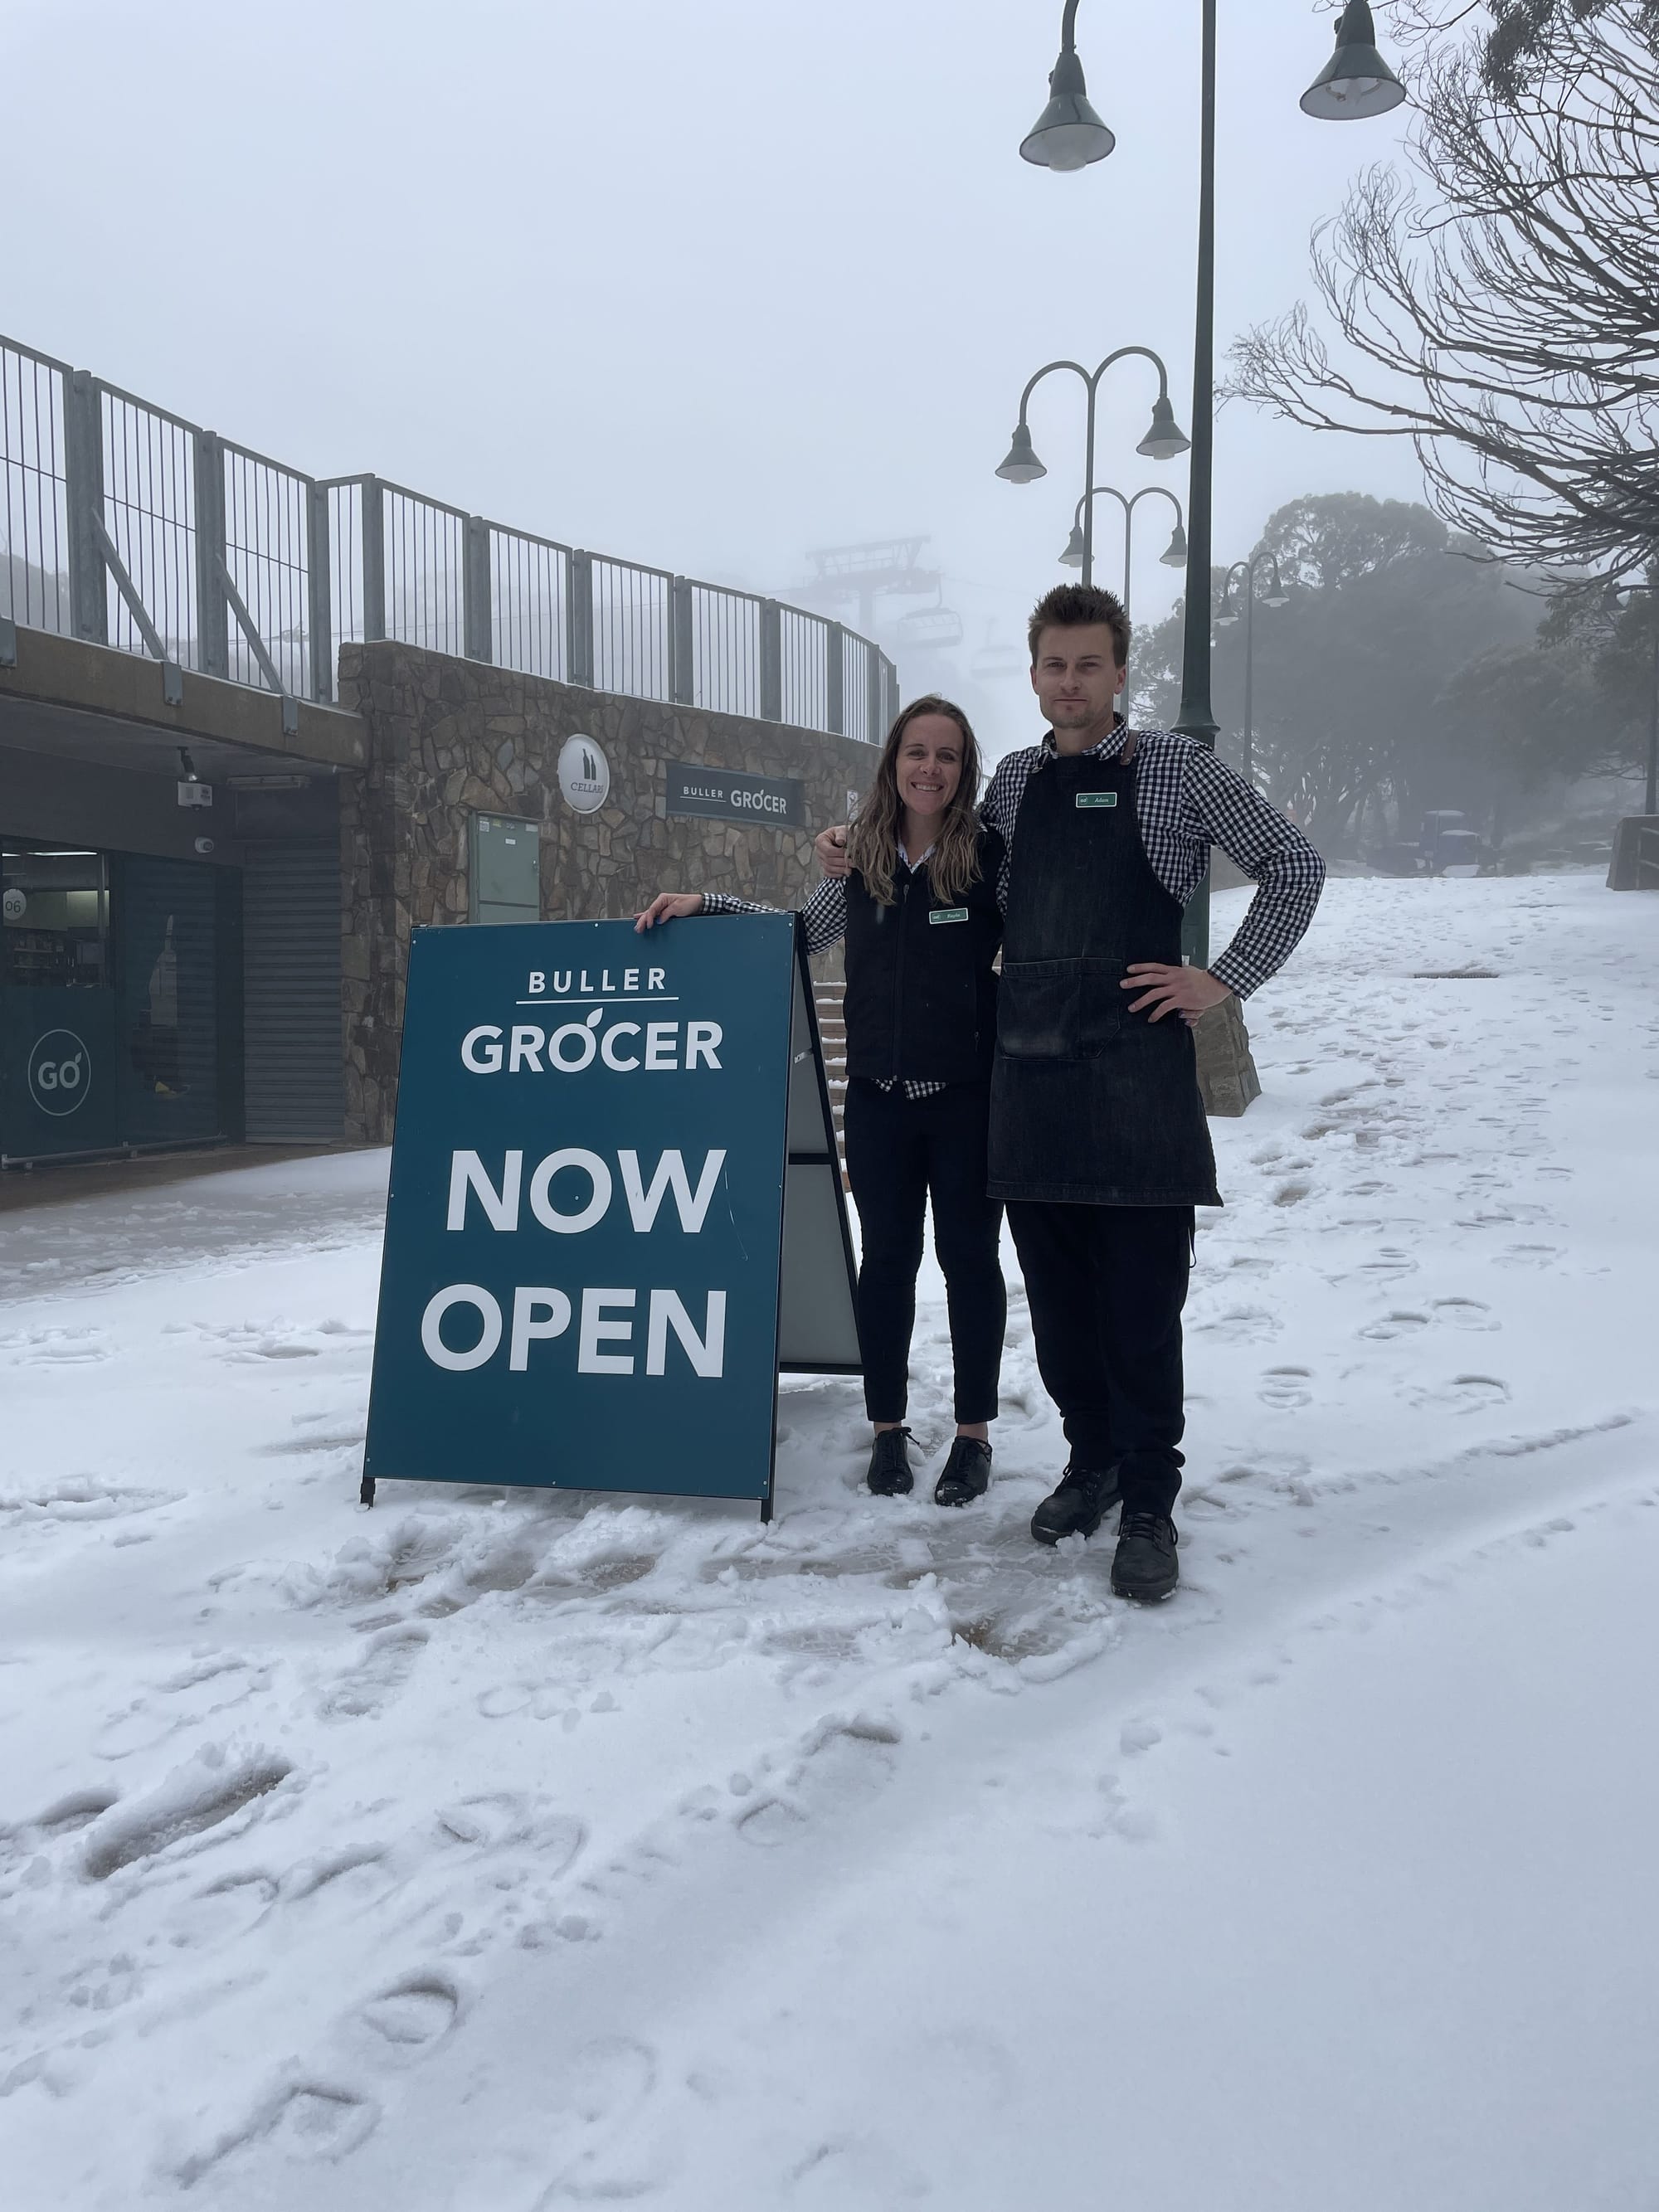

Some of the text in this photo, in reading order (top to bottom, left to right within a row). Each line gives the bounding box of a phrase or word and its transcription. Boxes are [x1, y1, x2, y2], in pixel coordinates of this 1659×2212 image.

[684, 786, 787, 814] BULLER GROCER
[528, 967, 666, 994] BULLER
[460, 1009, 724, 1074] GROCER
[37, 1053, 81, 1090] GO
[445, 1147, 727, 1234] NOW
[421, 1283, 727, 1378] OPEN
